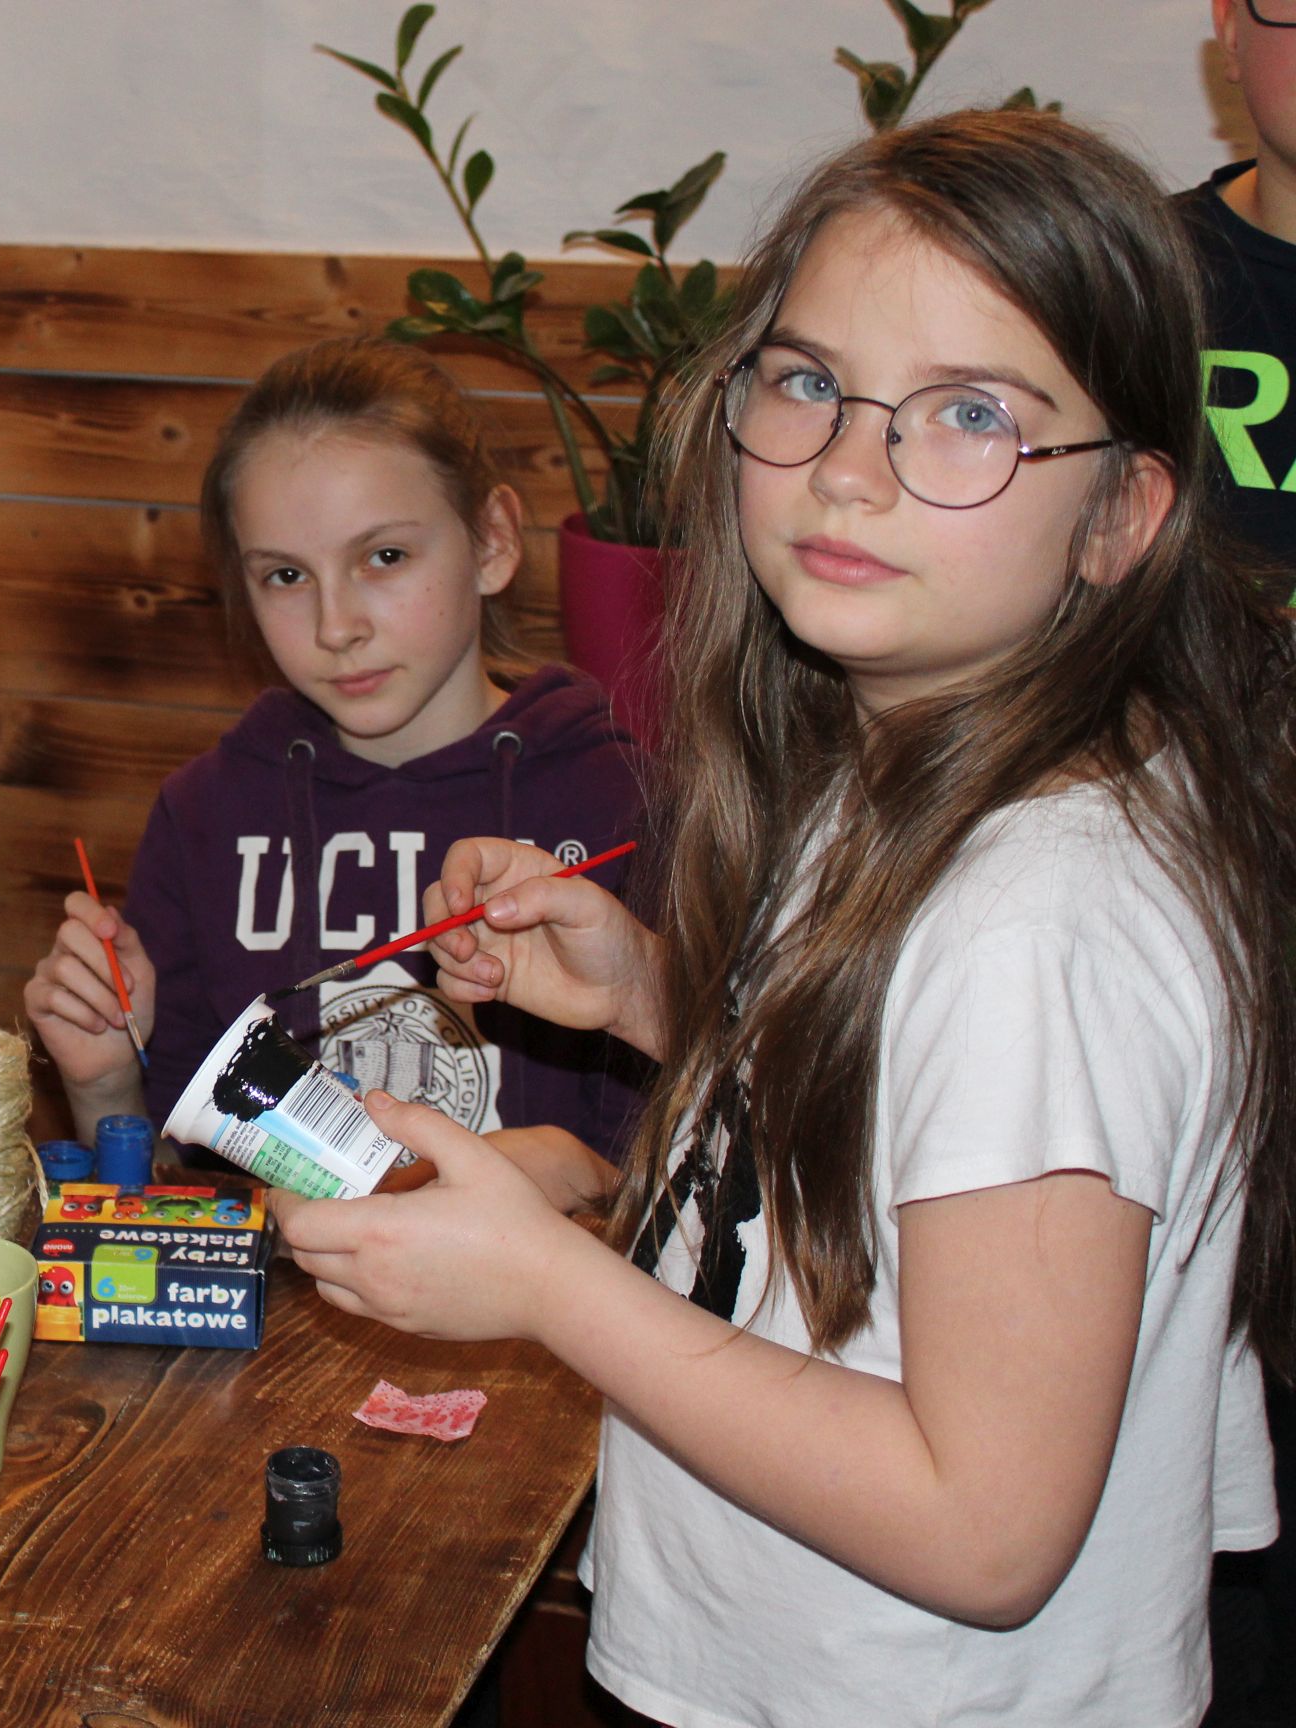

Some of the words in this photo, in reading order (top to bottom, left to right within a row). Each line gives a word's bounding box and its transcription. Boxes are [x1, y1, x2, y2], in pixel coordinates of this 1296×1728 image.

[1201, 349, 1296, 493] R
[235, 831, 535, 953] UCL
[325, 997, 384, 1029] RSITY
[402, 999, 432, 1017] OF
[372, 1137, 386, 1151] 135
[99, 1229, 253, 1247] plakatowe
[170, 1246, 249, 1265] farby
[97, 1276, 116, 1299] 6
[167, 1282, 247, 1310] farby
[92, 1305, 247, 1330] plakatowe
